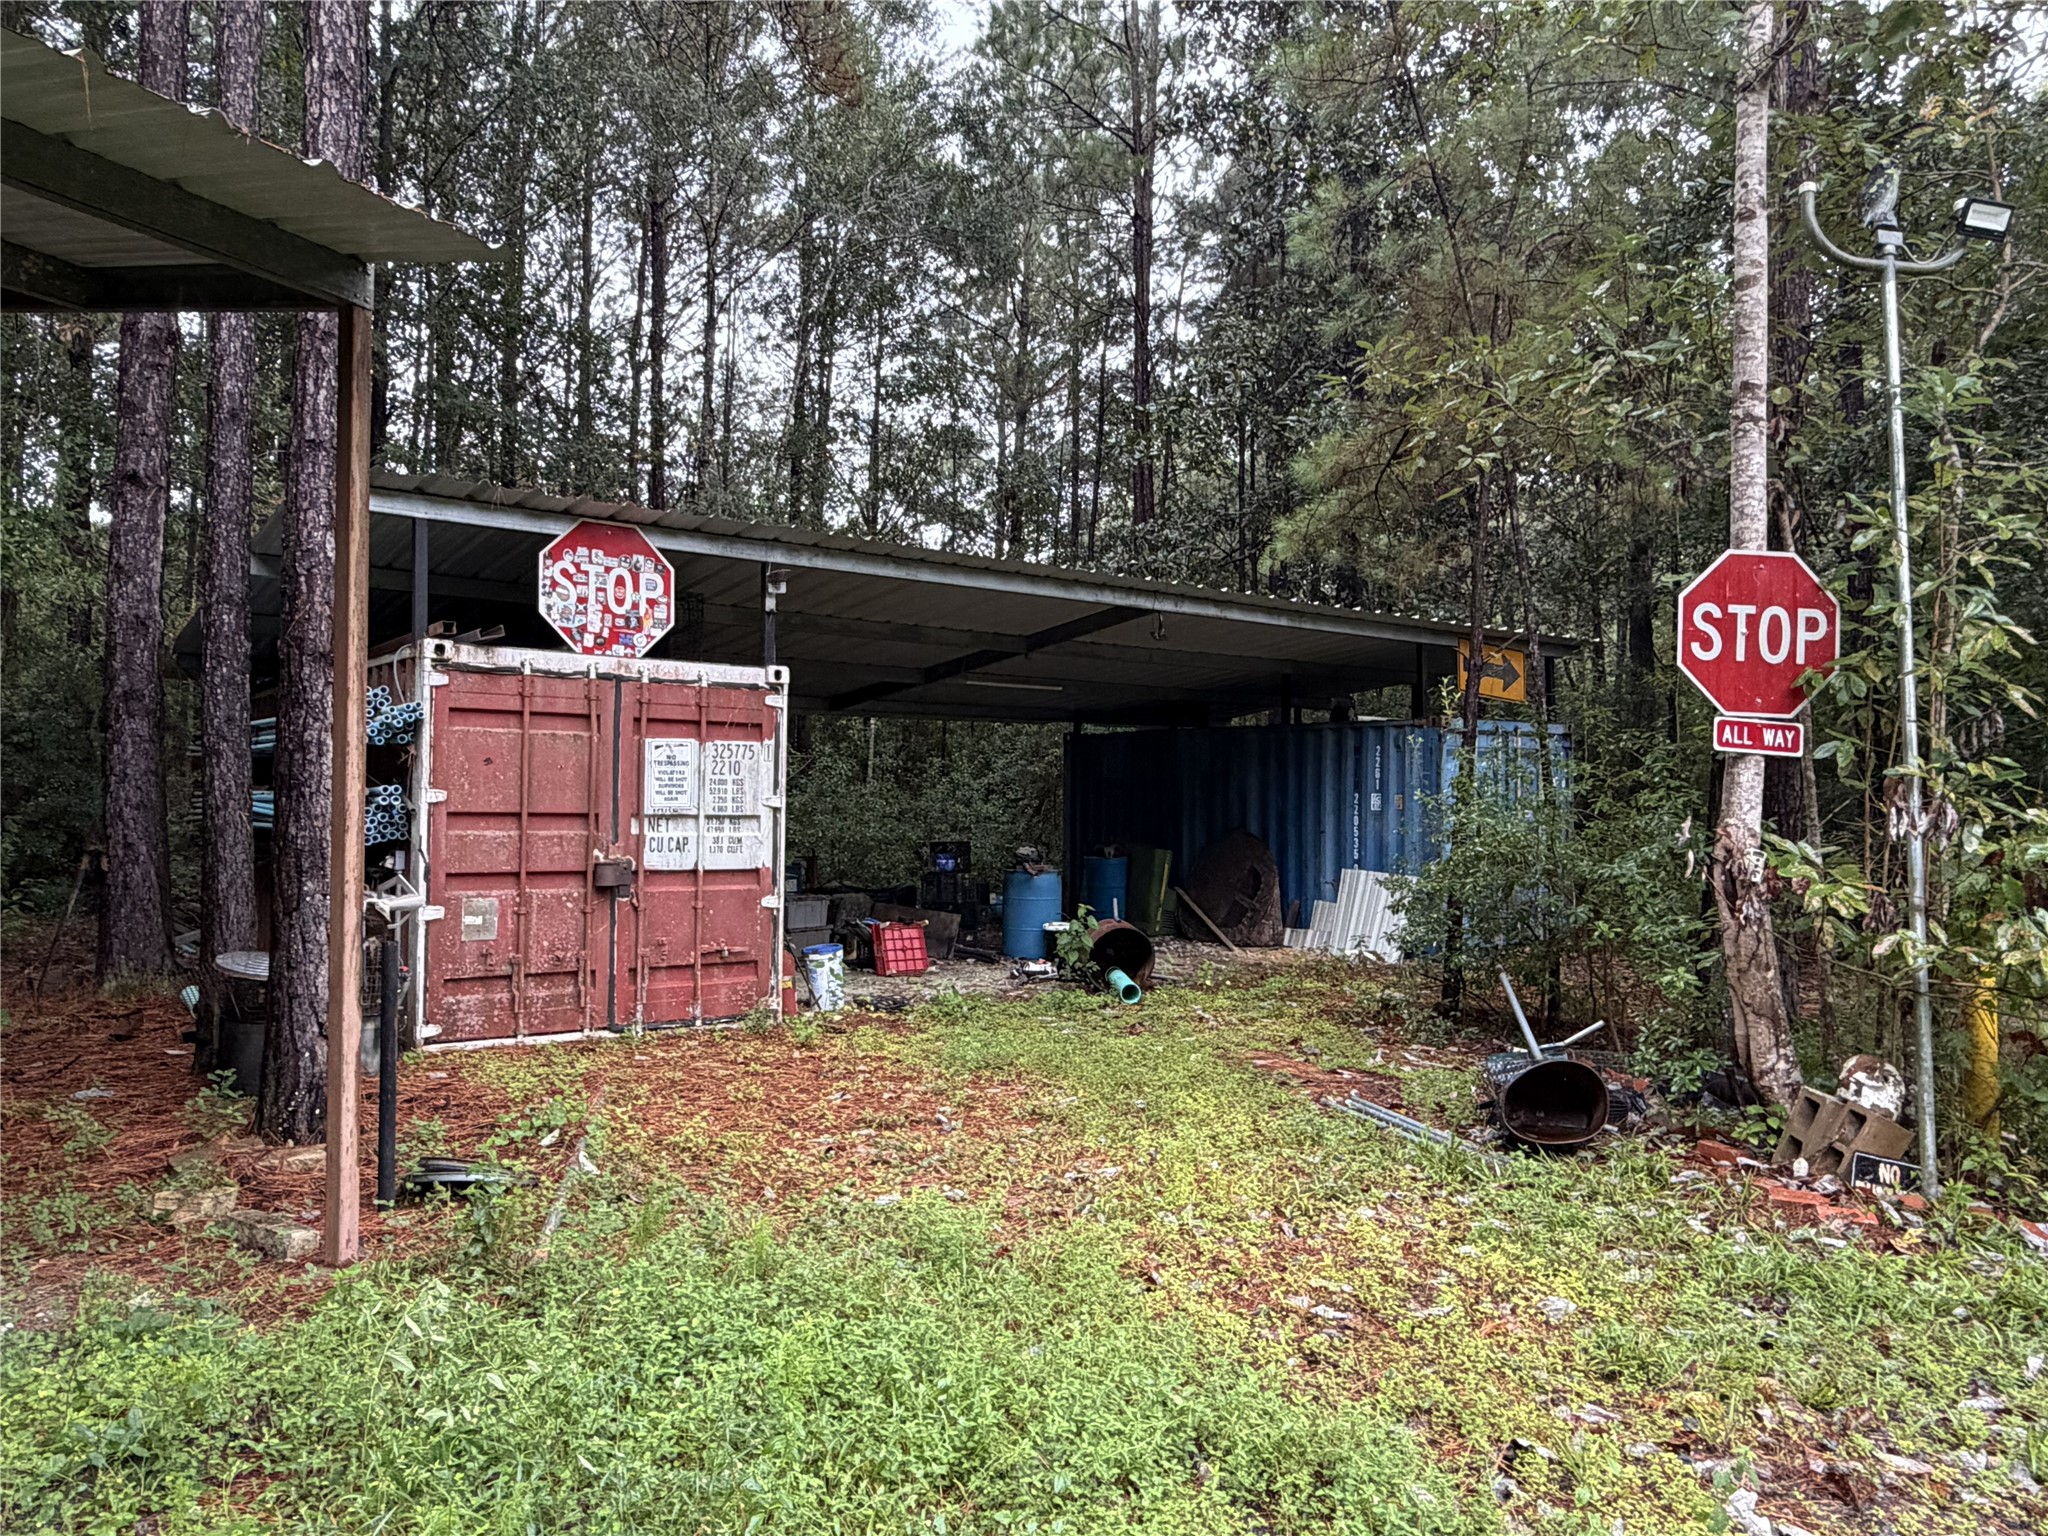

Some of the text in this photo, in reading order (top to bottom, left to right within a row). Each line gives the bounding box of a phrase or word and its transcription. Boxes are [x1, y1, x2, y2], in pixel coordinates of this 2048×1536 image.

[552, 560, 665, 617] STOP
[1690, 602, 1828, 665] STOP
[1722, 725, 1795, 748] ALL WAY
[711, 743, 755, 760] 325775
[711, 760, 741, 776] 2210
[732, 778, 744, 786] KGS
[732, 787, 744, 795] LBS
[732, 796, 744, 804] KGS
[732, 805, 744, 813] LBS
[648, 817, 671, 833] NET
[1878, 1162, 1901, 1185] NO
